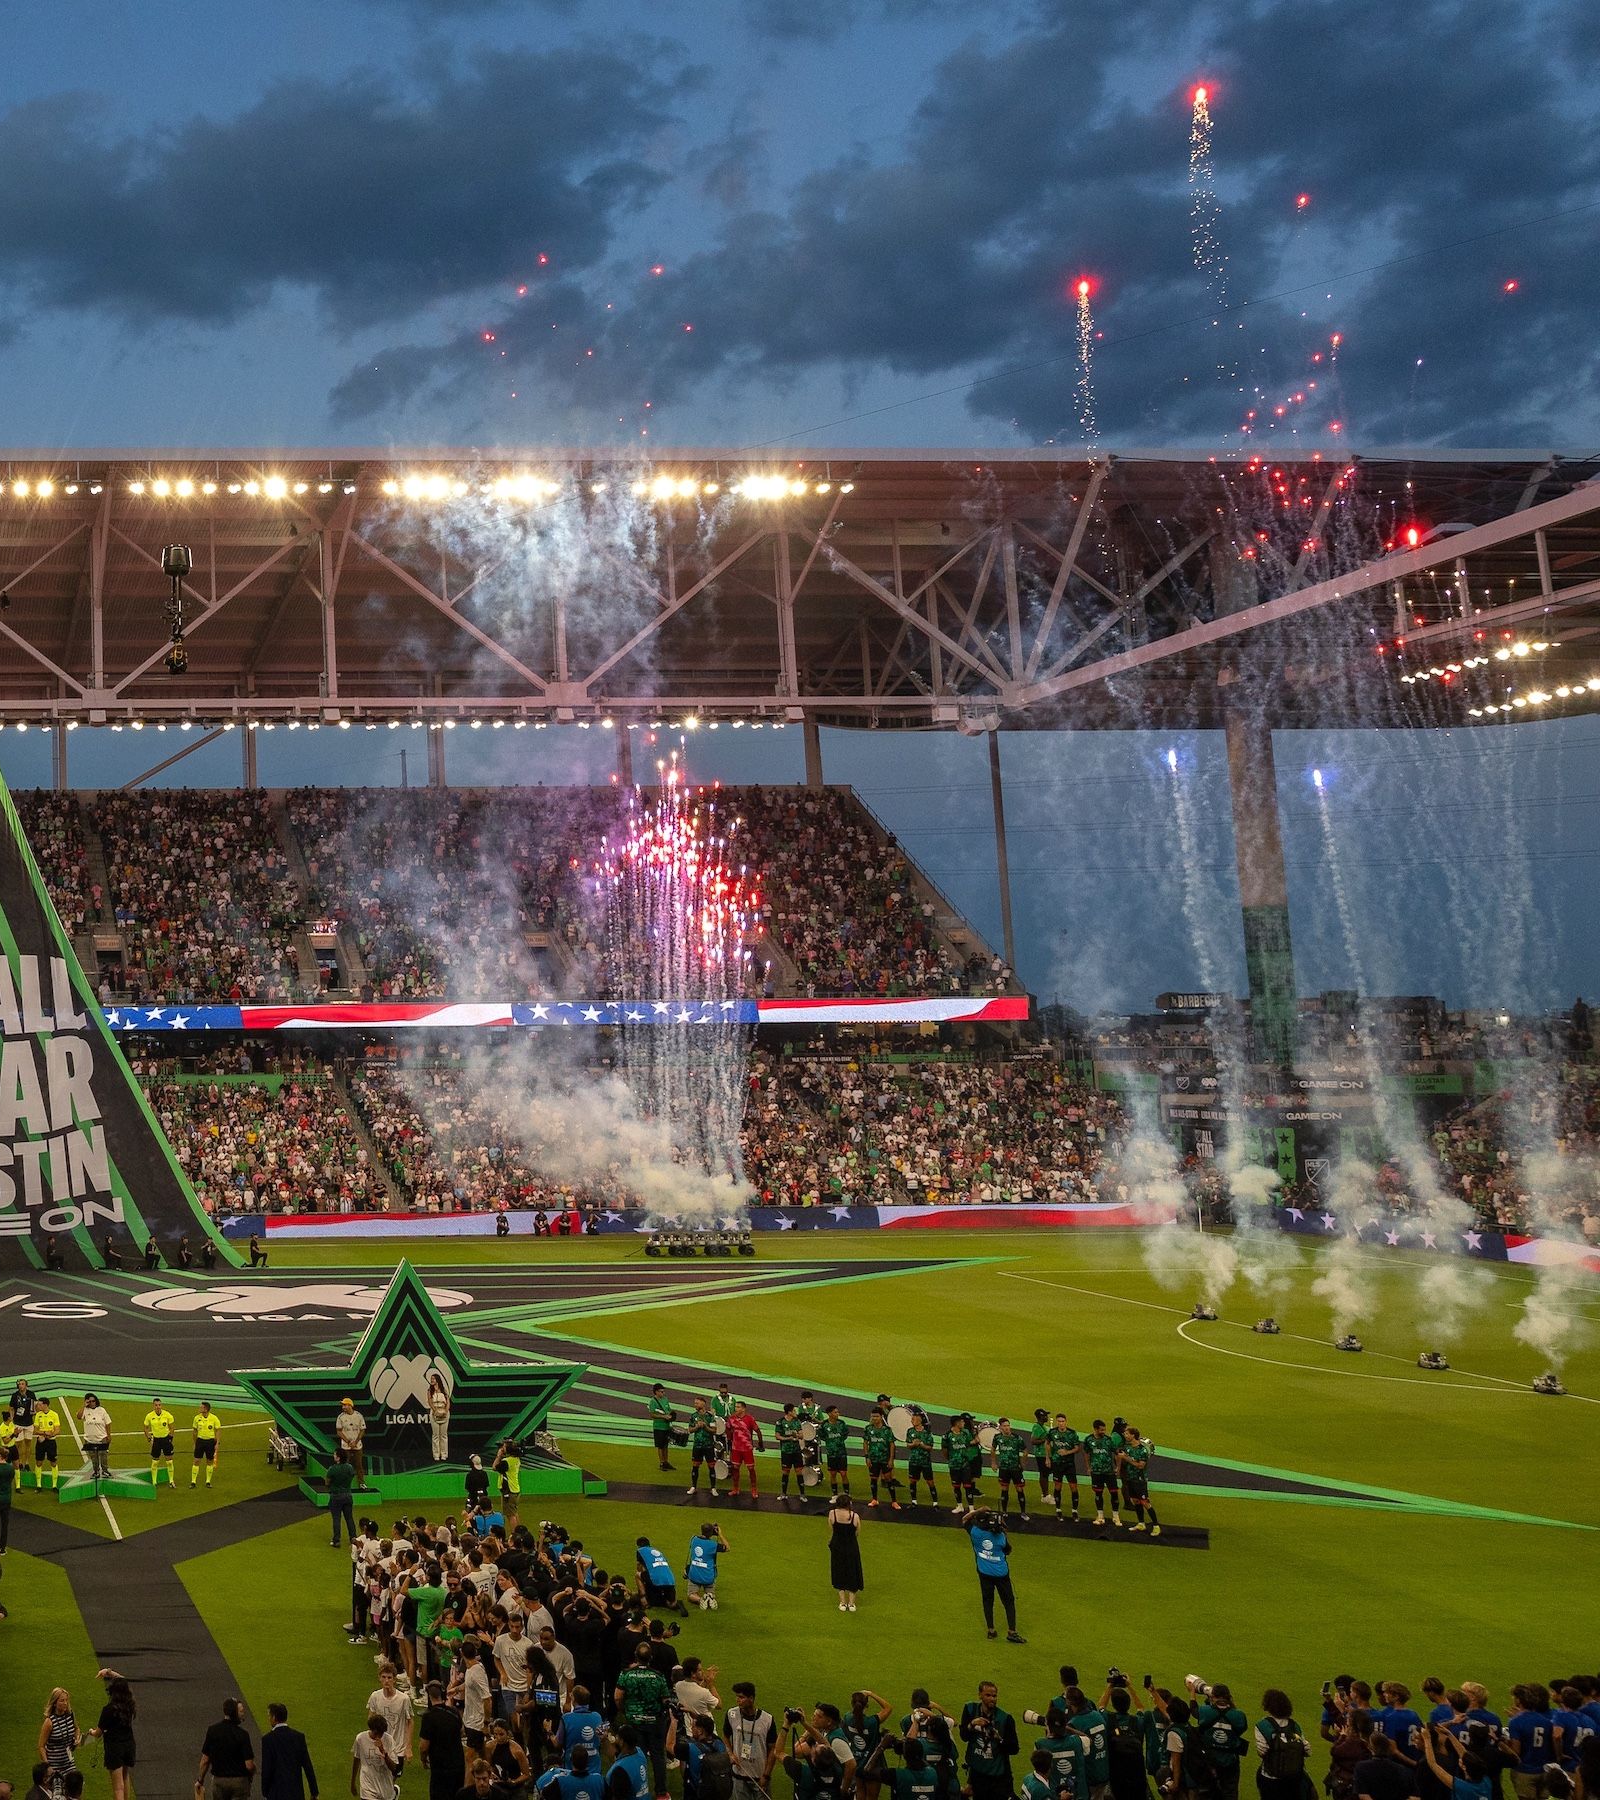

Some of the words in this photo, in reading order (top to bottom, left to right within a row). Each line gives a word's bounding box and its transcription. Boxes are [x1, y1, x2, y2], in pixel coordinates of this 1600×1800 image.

[1299, 1080, 1338, 1089] GAME
[1340, 1081, 1364, 1089] ON
[1286, 1112, 1320, 1120] GAME
[1321, 1112, 1342, 1120] ON
[1201, 1130, 1213, 1143] ALL
[1196, 1142, 1214, 1158] STAR
[40, 1197, 125, 1232] ON
[211, 1314, 335, 1322] LIGA
[385, 1414, 415, 1425] LIGA
[417, 1414, 432, 1425] M
[1533, 1727, 1545, 1748] 6
